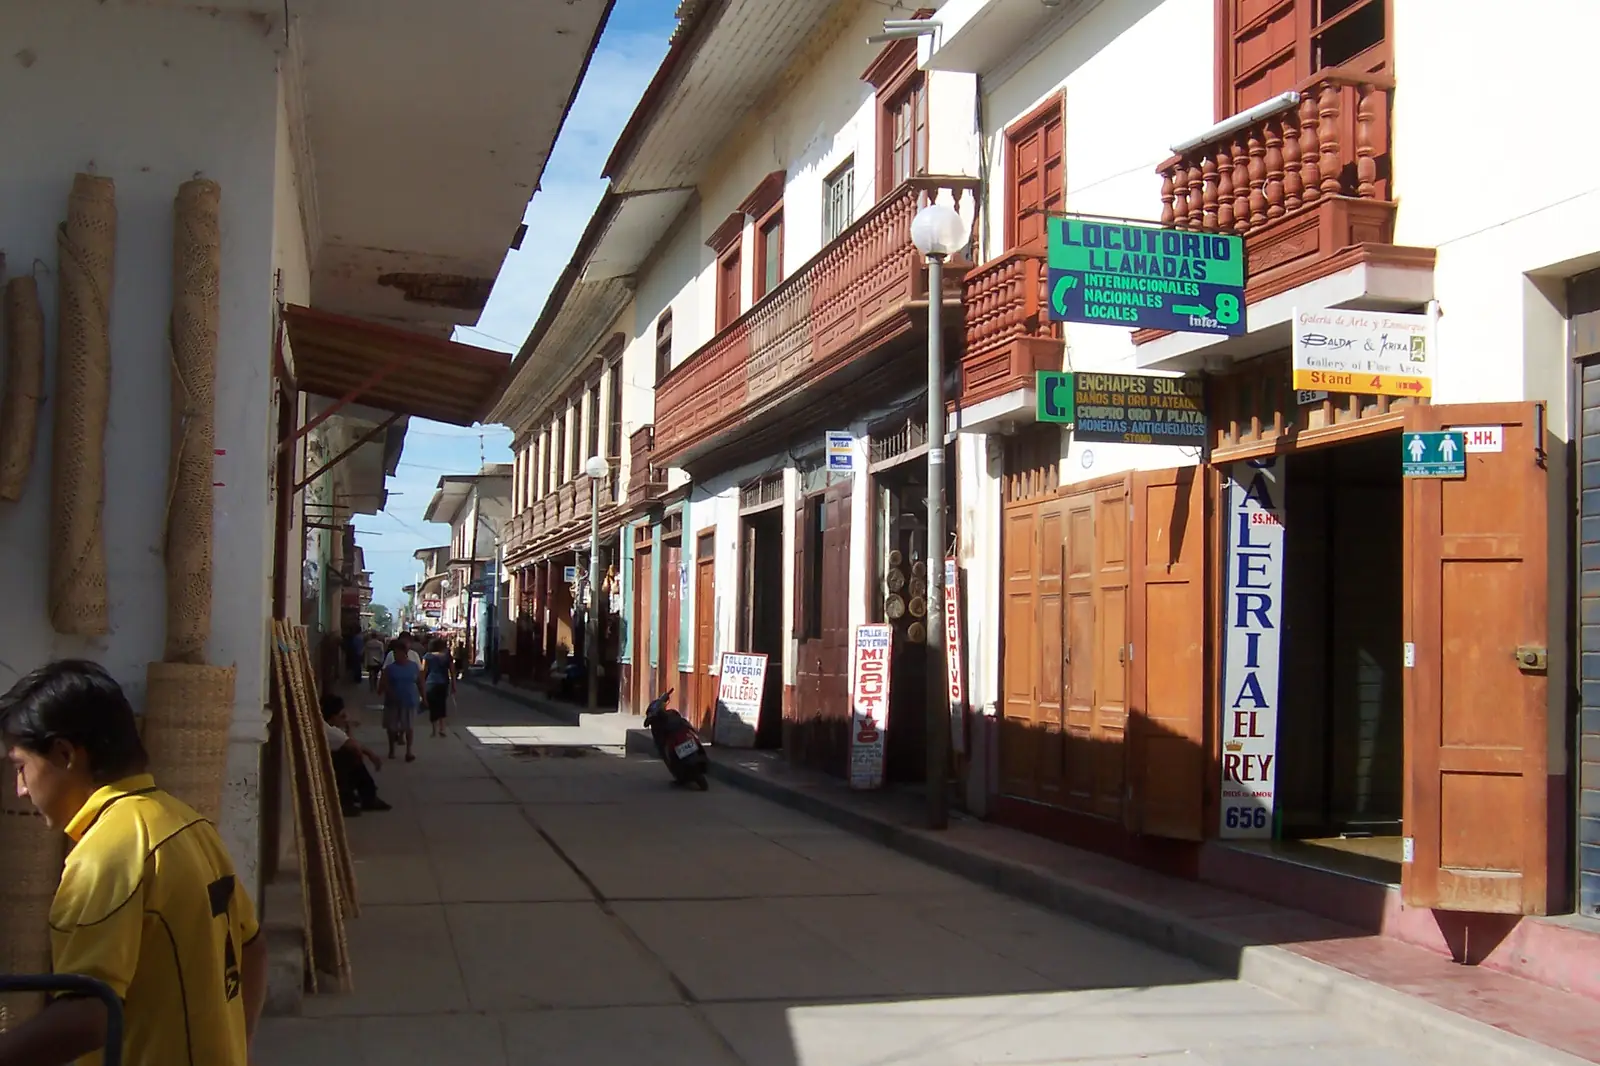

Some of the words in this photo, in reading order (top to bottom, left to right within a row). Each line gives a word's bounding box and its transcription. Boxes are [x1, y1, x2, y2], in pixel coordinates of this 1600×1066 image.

[1061, 221, 1230, 260] LOCUTORIO
[1089, 250, 1207, 280] LLAMADAS
[1084, 273, 1199, 296] INTERNACIONALES
[1084, 289, 1163, 308] NACIONALES
[1084, 304, 1138, 321] LOCALES
[1215, 293, 1239, 324] 8
[1364, 341, 1374, 351] &
[1307, 356, 1345, 370] Gallery
[1352, 359, 1361, 369] of
[1367, 361, 1390, 371] Fine
[1079, 374, 1146, 393] ENCHAPES
[1311, 371, 1352, 385] Stand
[1370, 375, 1382, 389] 4
[1112, 393, 1124, 405] EN
[1128, 395, 1147, 406] ORO
[1077, 405, 1124, 420] COMPRO
[1128, 408, 1151, 421] ORO
[1155, 409, 1164, 421] Y
[1167, 410, 1204, 423] PLATA
[858, 629, 882, 638] TALLER
[858, 638, 888, 647] JOYERIA
[724, 655, 752, 666] TALLER
[860, 649, 883, 660] MI
[724, 666, 761, 676] JOYERIA
[1233, 711, 1264, 738] EL
[1223, 753, 1273, 785] REY
[1252, 790, 1272, 798] AMOR
[1226, 807, 1265, 829] 656
